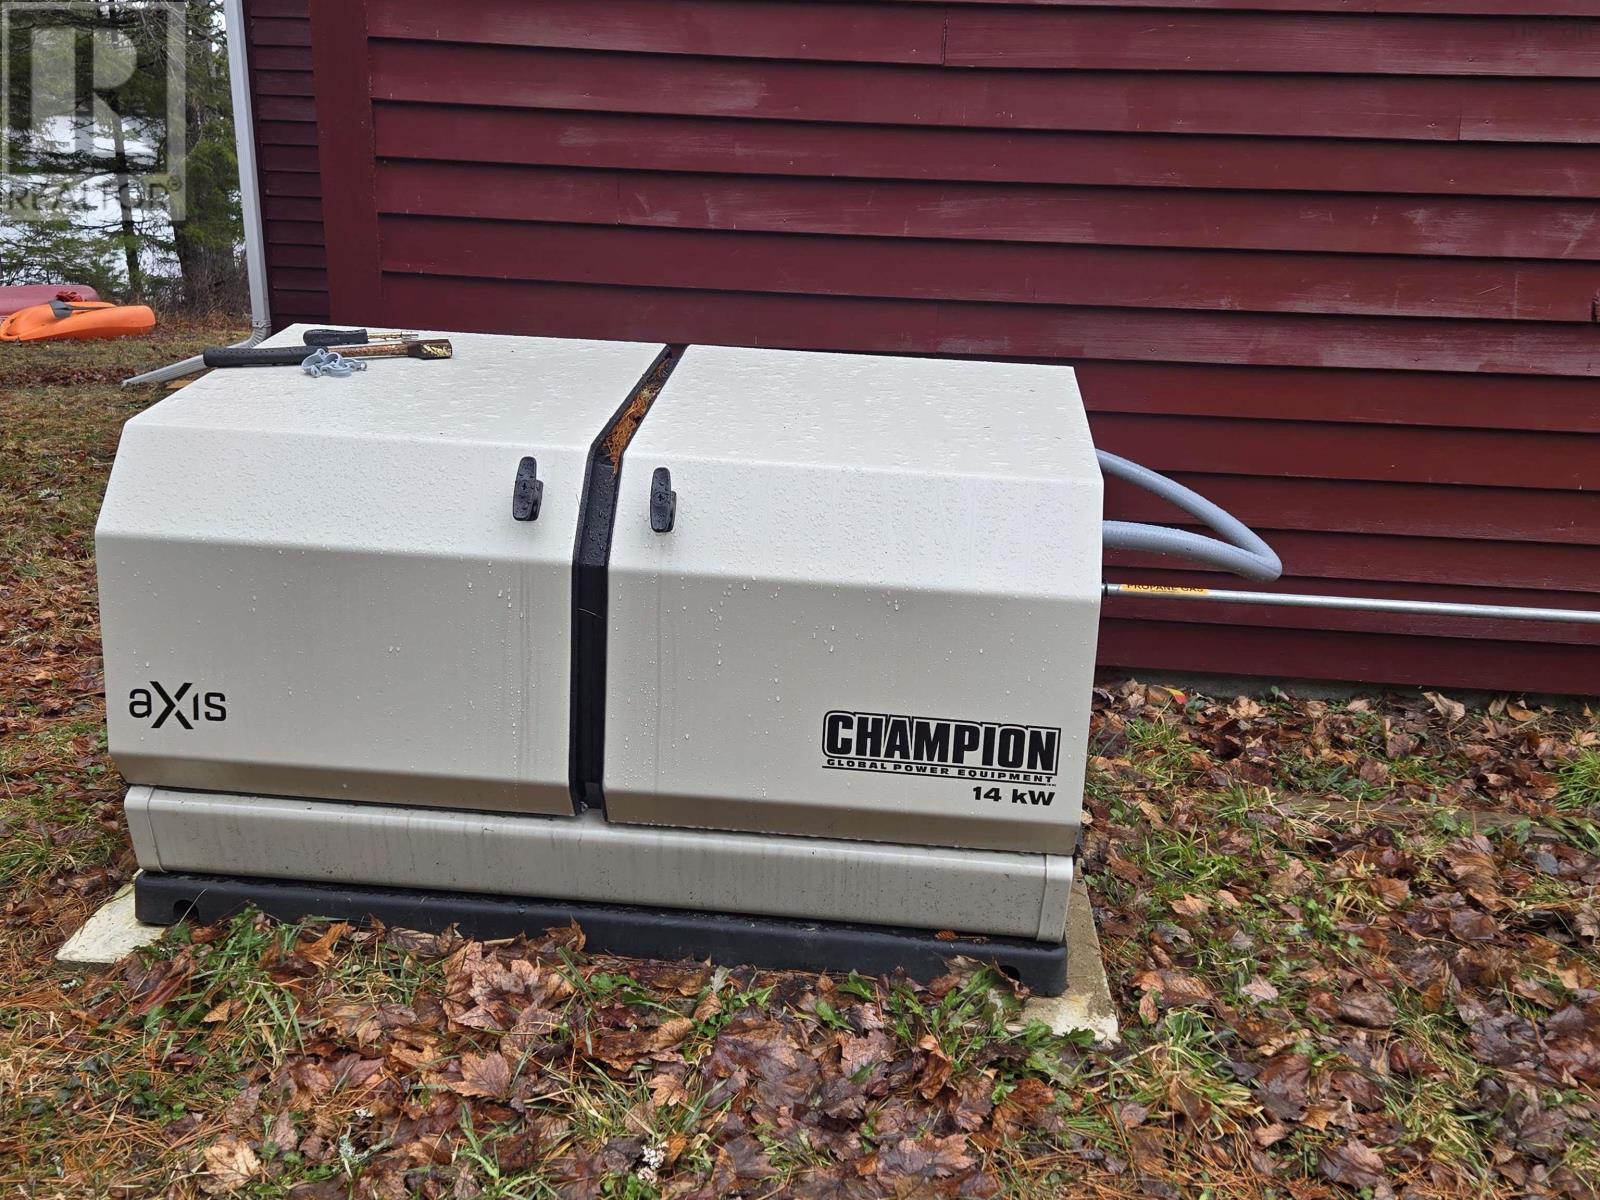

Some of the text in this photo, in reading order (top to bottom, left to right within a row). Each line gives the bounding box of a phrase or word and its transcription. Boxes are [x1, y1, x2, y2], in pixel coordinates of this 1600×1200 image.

[826, 714, 1057, 771] CHAMPION
[826, 758, 1053, 783] GLOBAL POWER EQUIPMENT
[972, 786, 1056, 806] 14 kW
